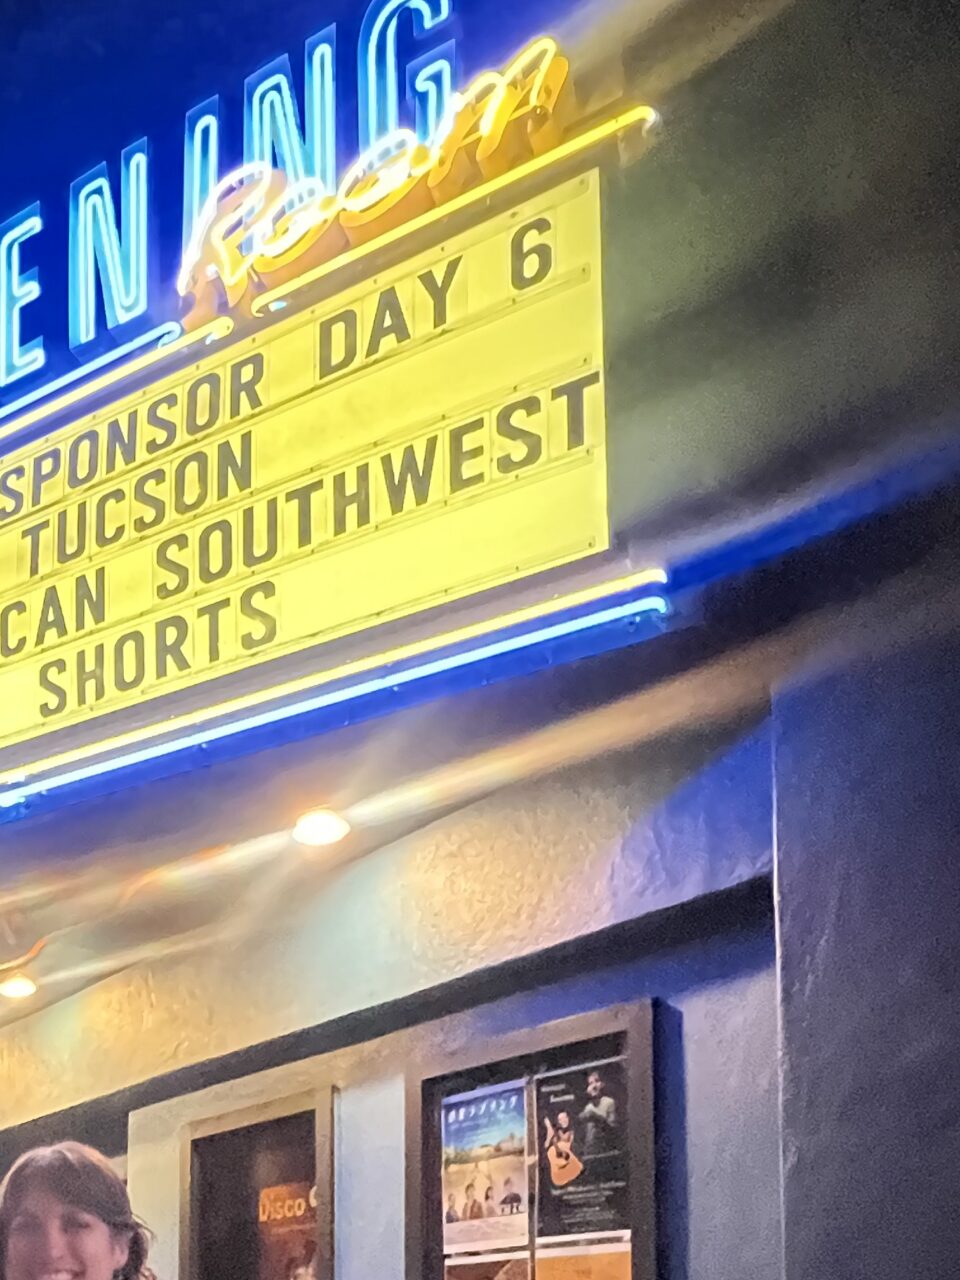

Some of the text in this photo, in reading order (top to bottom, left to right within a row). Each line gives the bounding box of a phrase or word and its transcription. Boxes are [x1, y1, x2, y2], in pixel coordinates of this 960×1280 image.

[176, 34, 569, 308] Room
[318, 254, 464, 381] DAY
[510, 217, 553, 291] 6
[20, 429, 253, 578] TUCSON
[155, 371, 601, 600] SOUTHWEST
[38, 580, 278, 719] SHORTS
